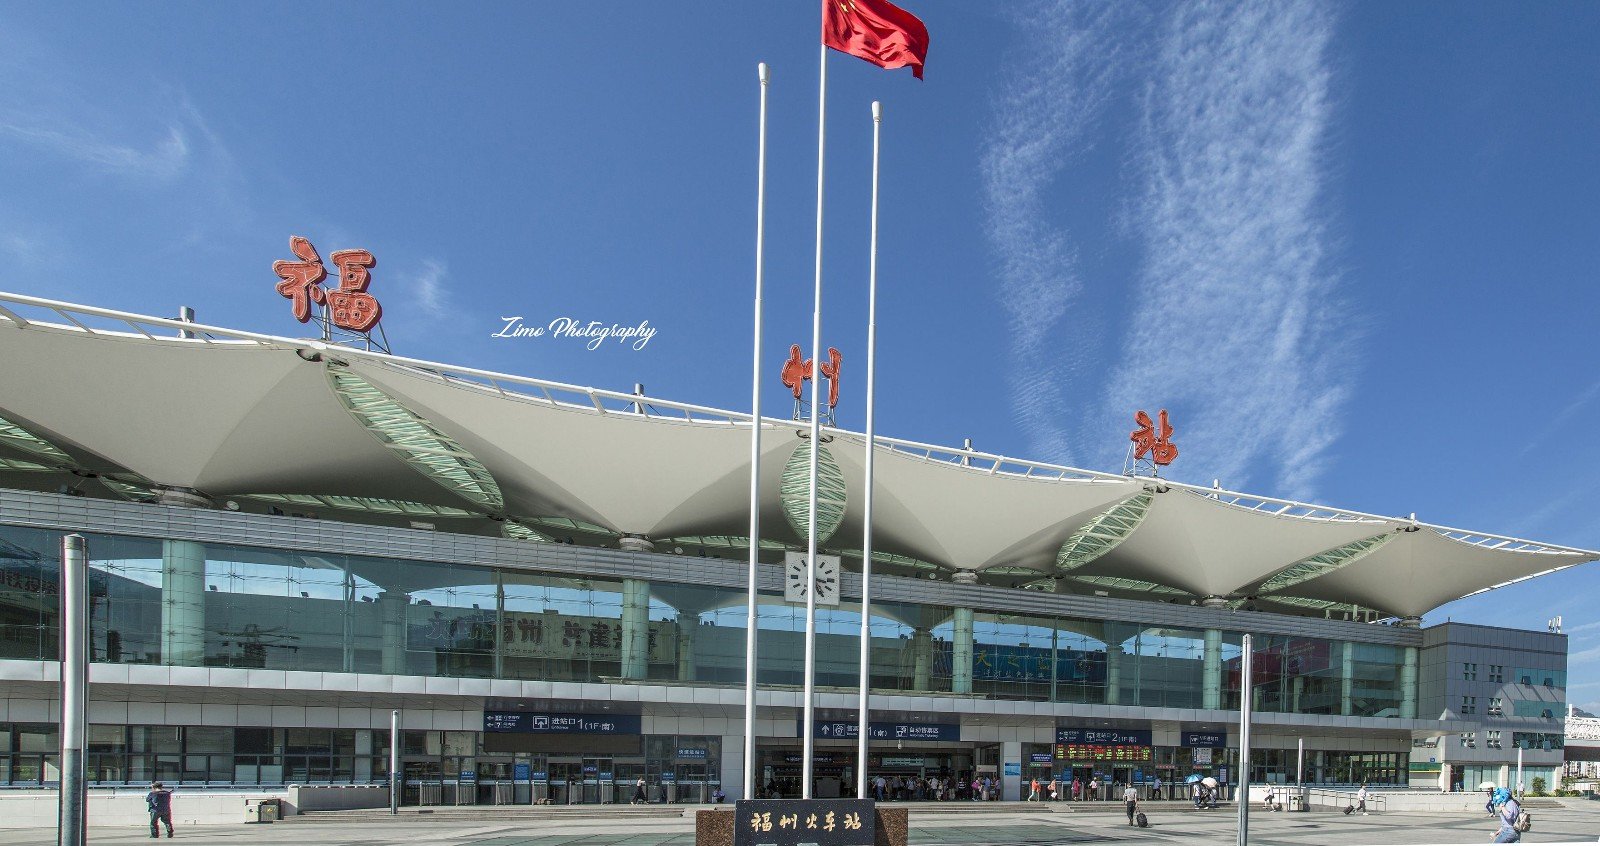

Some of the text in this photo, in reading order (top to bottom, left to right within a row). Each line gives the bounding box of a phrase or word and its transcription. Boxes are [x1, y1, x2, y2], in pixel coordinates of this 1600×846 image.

[272, 235, 1178, 466] 福 州 站
[750, 810, 861, 832] 福州火车站
